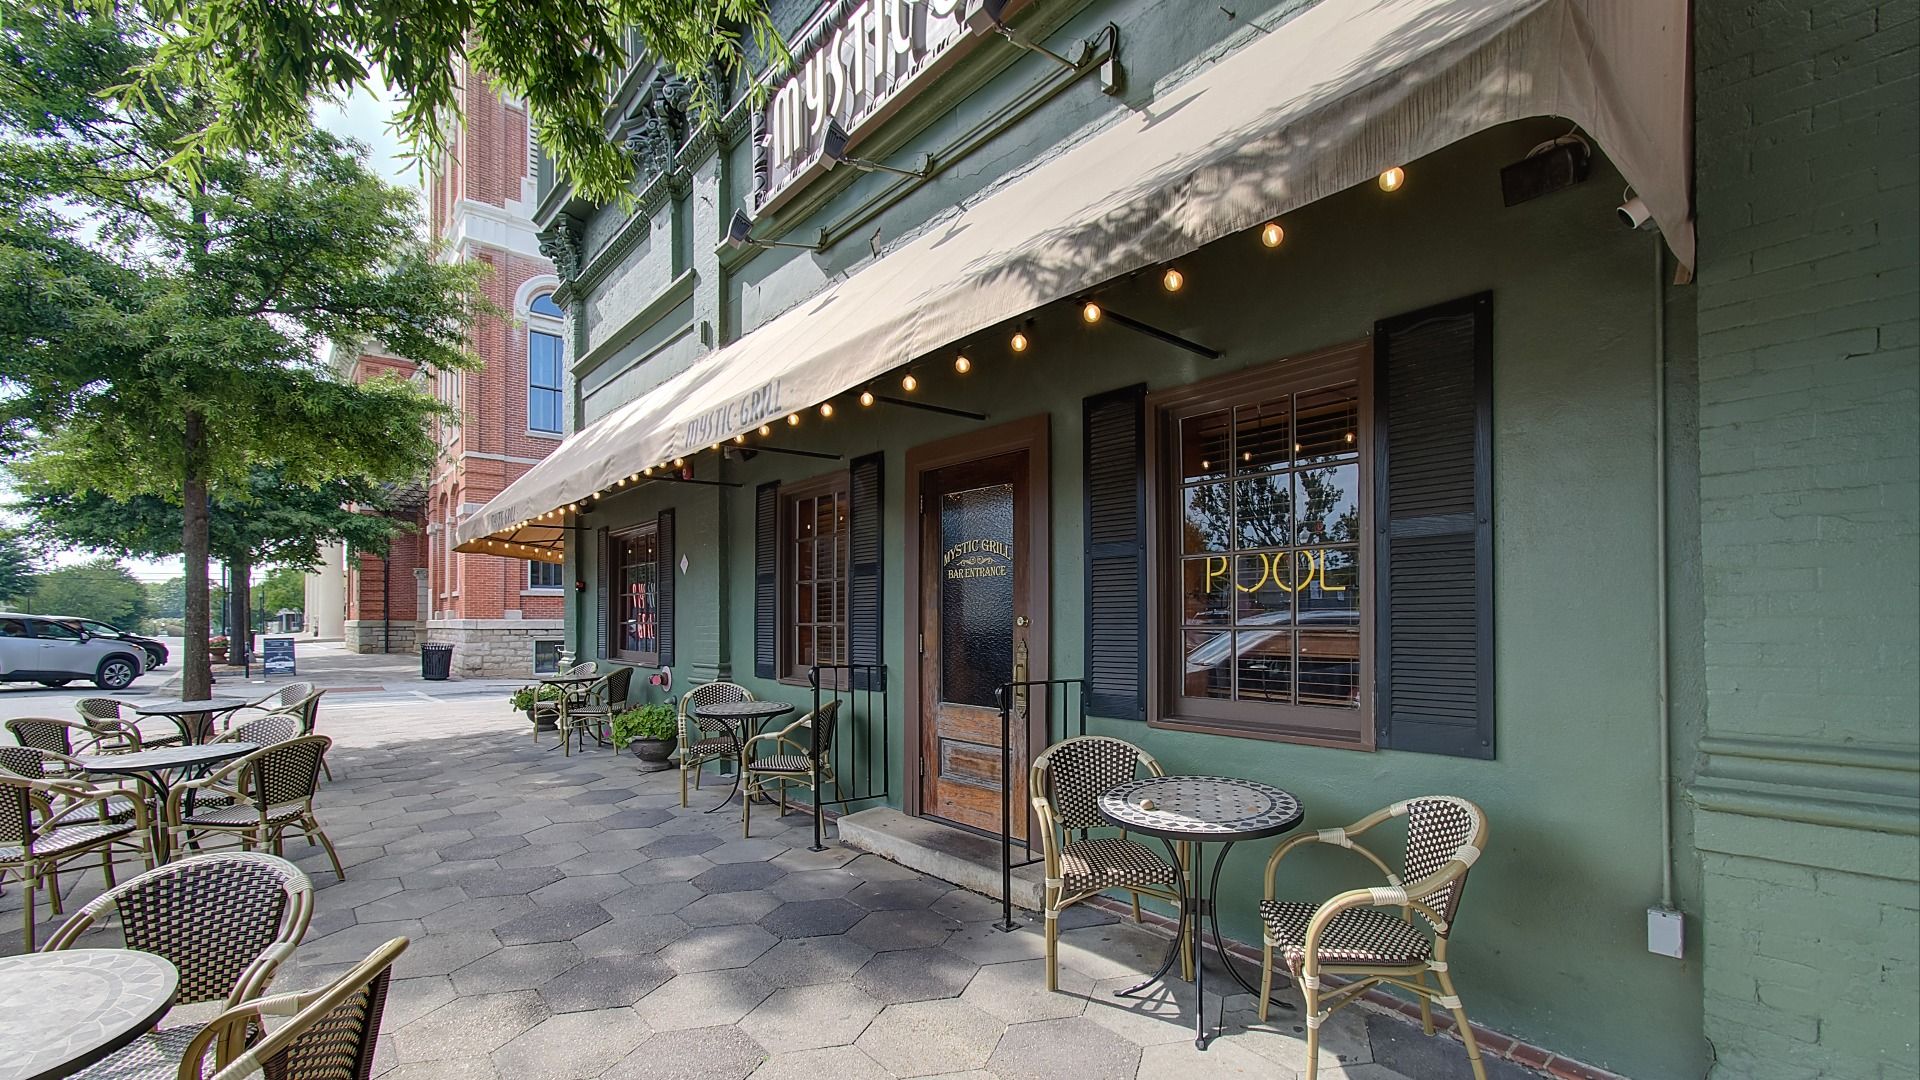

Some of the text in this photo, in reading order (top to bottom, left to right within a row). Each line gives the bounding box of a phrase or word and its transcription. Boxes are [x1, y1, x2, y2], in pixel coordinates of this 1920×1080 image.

[686, 380, 782, 448] MYSTIC GRILL
[944, 539, 1011, 566] MYSTIC GRILL
[948, 565, 1006, 579] BAR ENTRANCE
[1206, 549, 1346, 593] POOL
